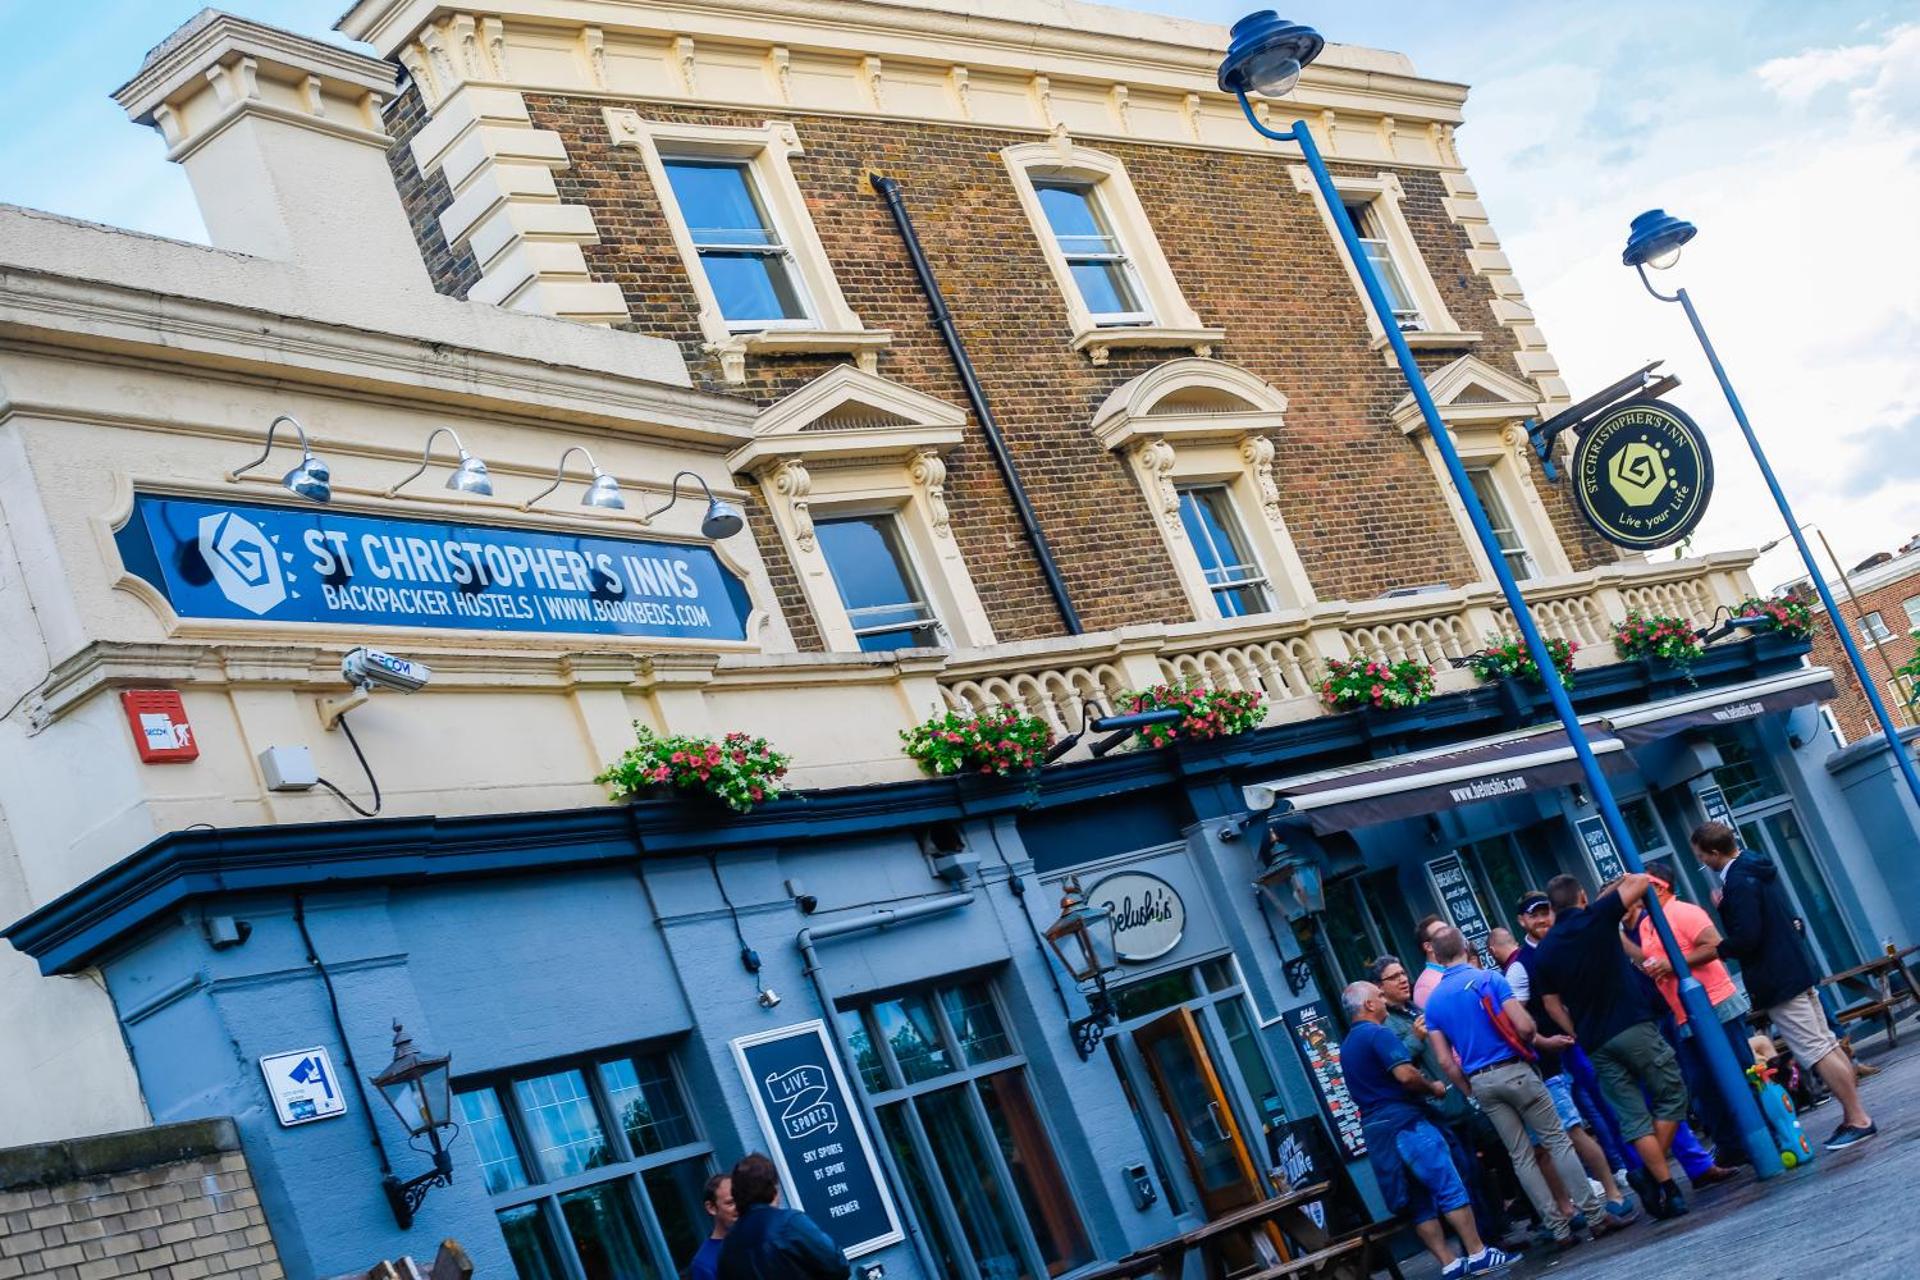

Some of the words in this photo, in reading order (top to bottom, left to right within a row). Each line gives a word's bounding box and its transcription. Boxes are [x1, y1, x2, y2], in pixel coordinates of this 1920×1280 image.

[1662, 422, 1687, 448] INN
[1619, 512, 1641, 528] Live
[1645, 509, 1669, 530] your
[1669, 486, 1689, 510] Life
[303, 528, 354, 577] ST
[361, 533, 624, 594] CHRISTOPHER'S
[622, 555, 699, 599] INNS
[321, 584, 453, 615] BACKPACKER
[452, 591, 535, 620] HOSTELS
[542, 596, 711, 628] WWW.BOOKBEDS.COM
[1450, 777, 1527, 802] www.belushis.com
[1591, 843, 1613, 861] HOUR
[1452, 899, 1477, 921] 8AM
[782, 1070, 810, 1094] LIVE
[791, 1107, 828, 1132] SPORTS
[803, 1149, 817, 1163] SKY
[817, 1142, 844, 1158] SPORTS
[813, 1168, 824, 1180] BT
[824, 1161, 846, 1176] SPORT
[827, 1182, 849, 1197] ESPN
[829, 1199, 860, 1218] PREMIER
